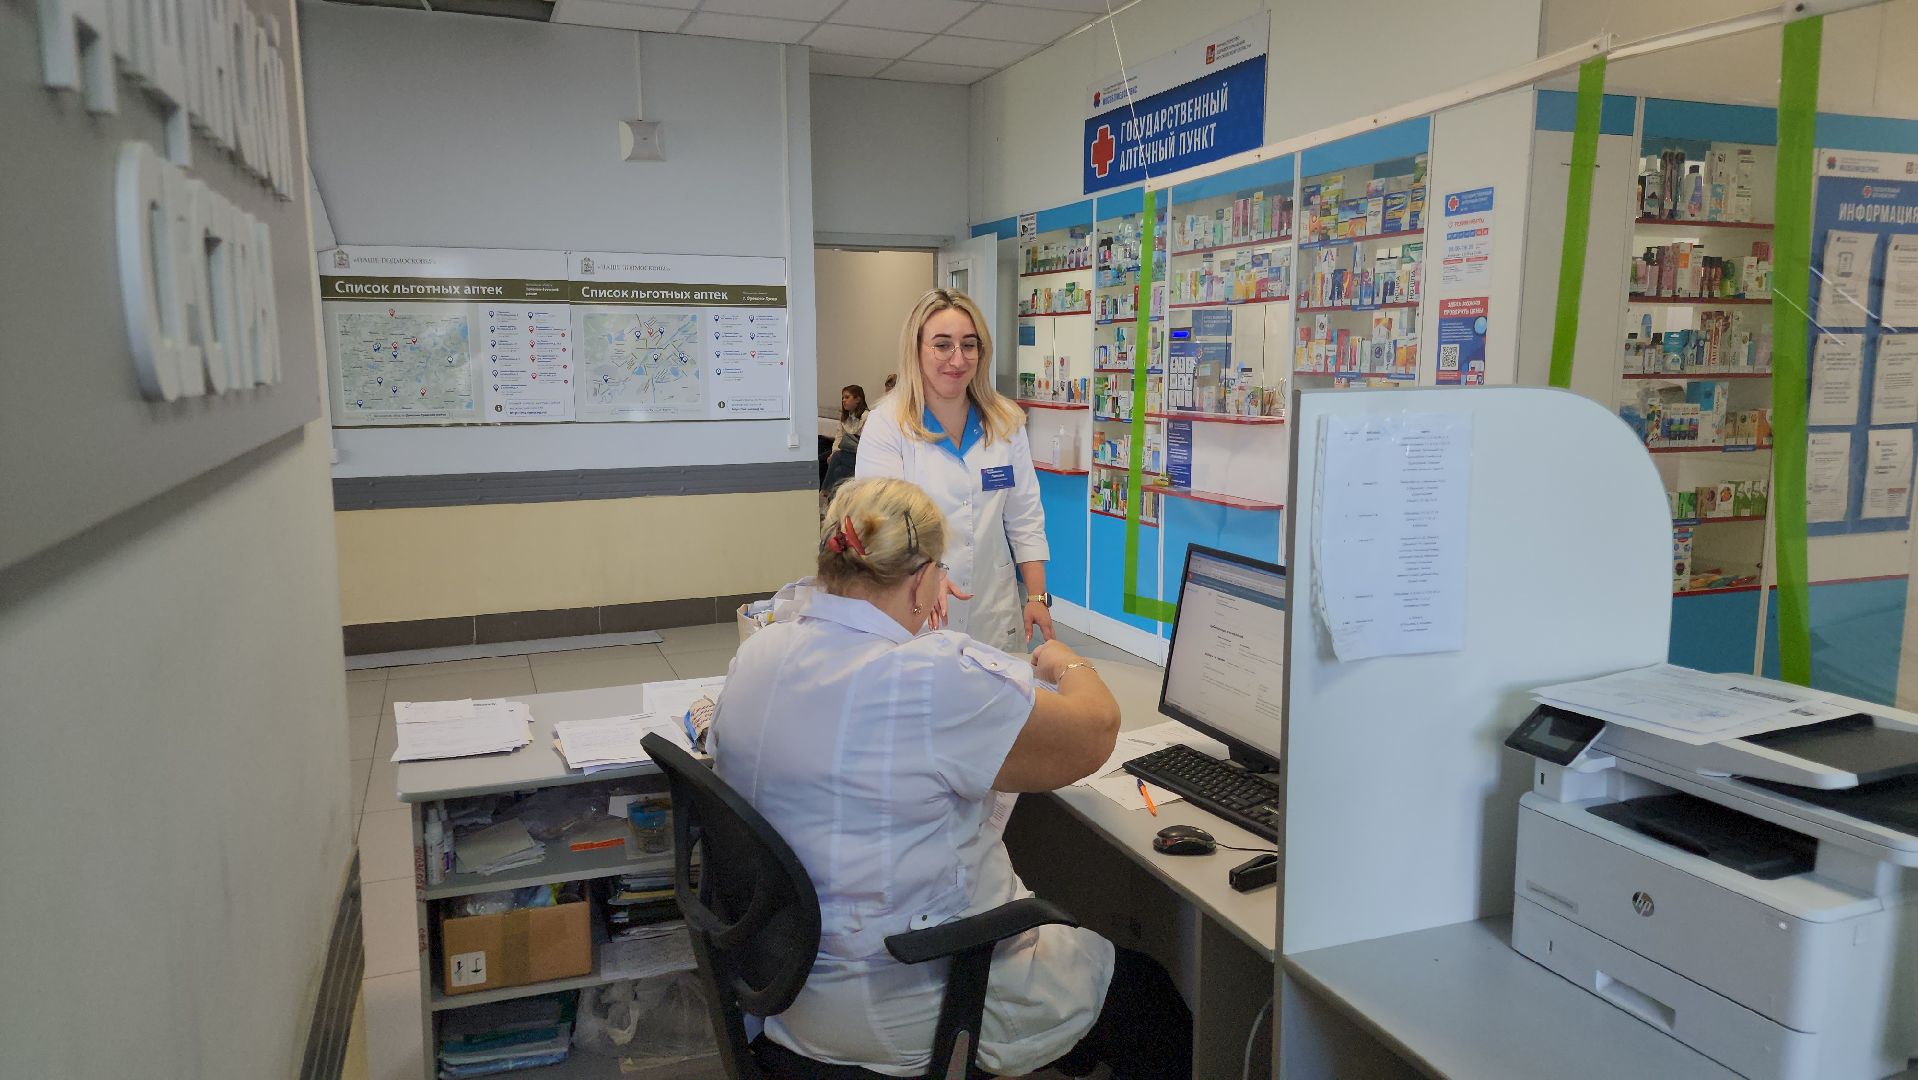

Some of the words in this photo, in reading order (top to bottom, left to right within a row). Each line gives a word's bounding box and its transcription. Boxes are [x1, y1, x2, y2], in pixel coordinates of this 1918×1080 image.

[1121, 82, 1229, 144] ГОСУДАРСТВЕННЫЙ
[1119, 132, 1175, 172] АПТЕЧНЫЙ
[1179, 123, 1217, 156] ПУНКТ
[335, 281, 390, 294] Список
[392, 284, 460, 295] льготных
[463, 285, 503, 295] аптек
[581, 286, 629, 298] Список
[630, 289, 691, 299] льготных
[693, 291, 729, 300] аптек
